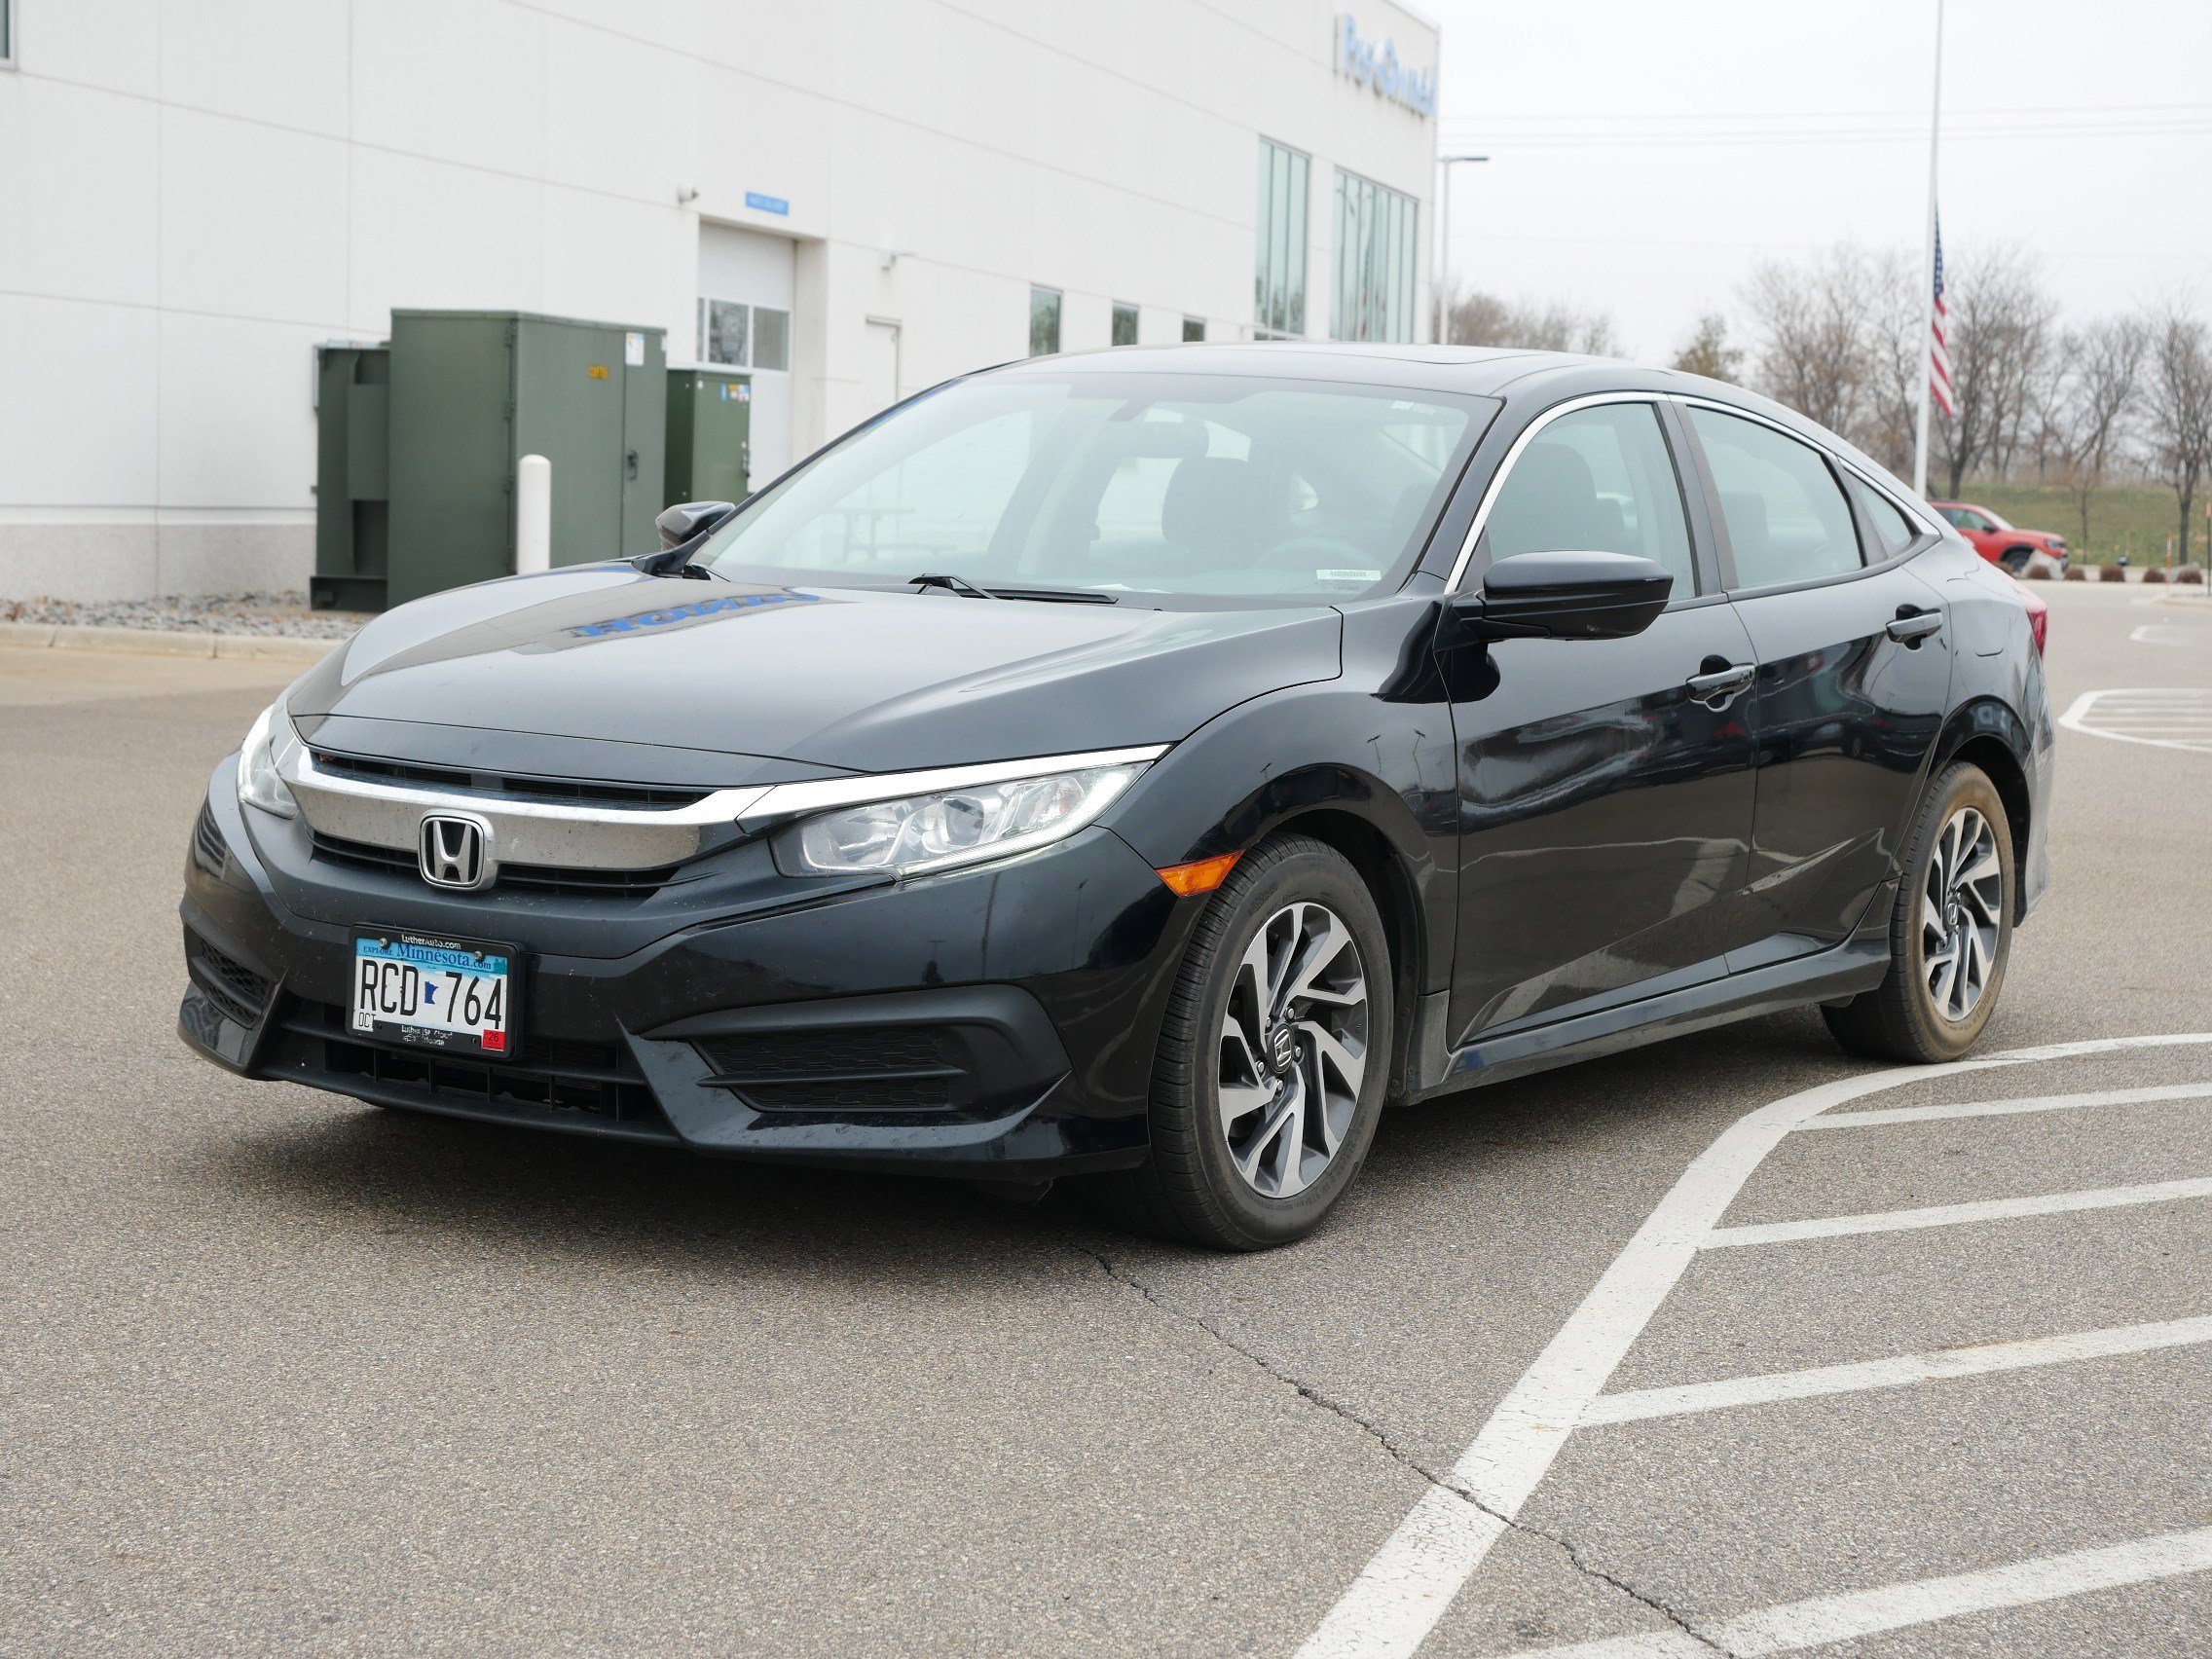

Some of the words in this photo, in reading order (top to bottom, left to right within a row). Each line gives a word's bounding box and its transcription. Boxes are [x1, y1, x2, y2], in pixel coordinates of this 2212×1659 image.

[362, 944, 394, 956] EXPLORE
[359, 959, 420, 1016] RCD
[445, 971, 502, 1030] 764
[357, 1012, 377, 1028] OCT
